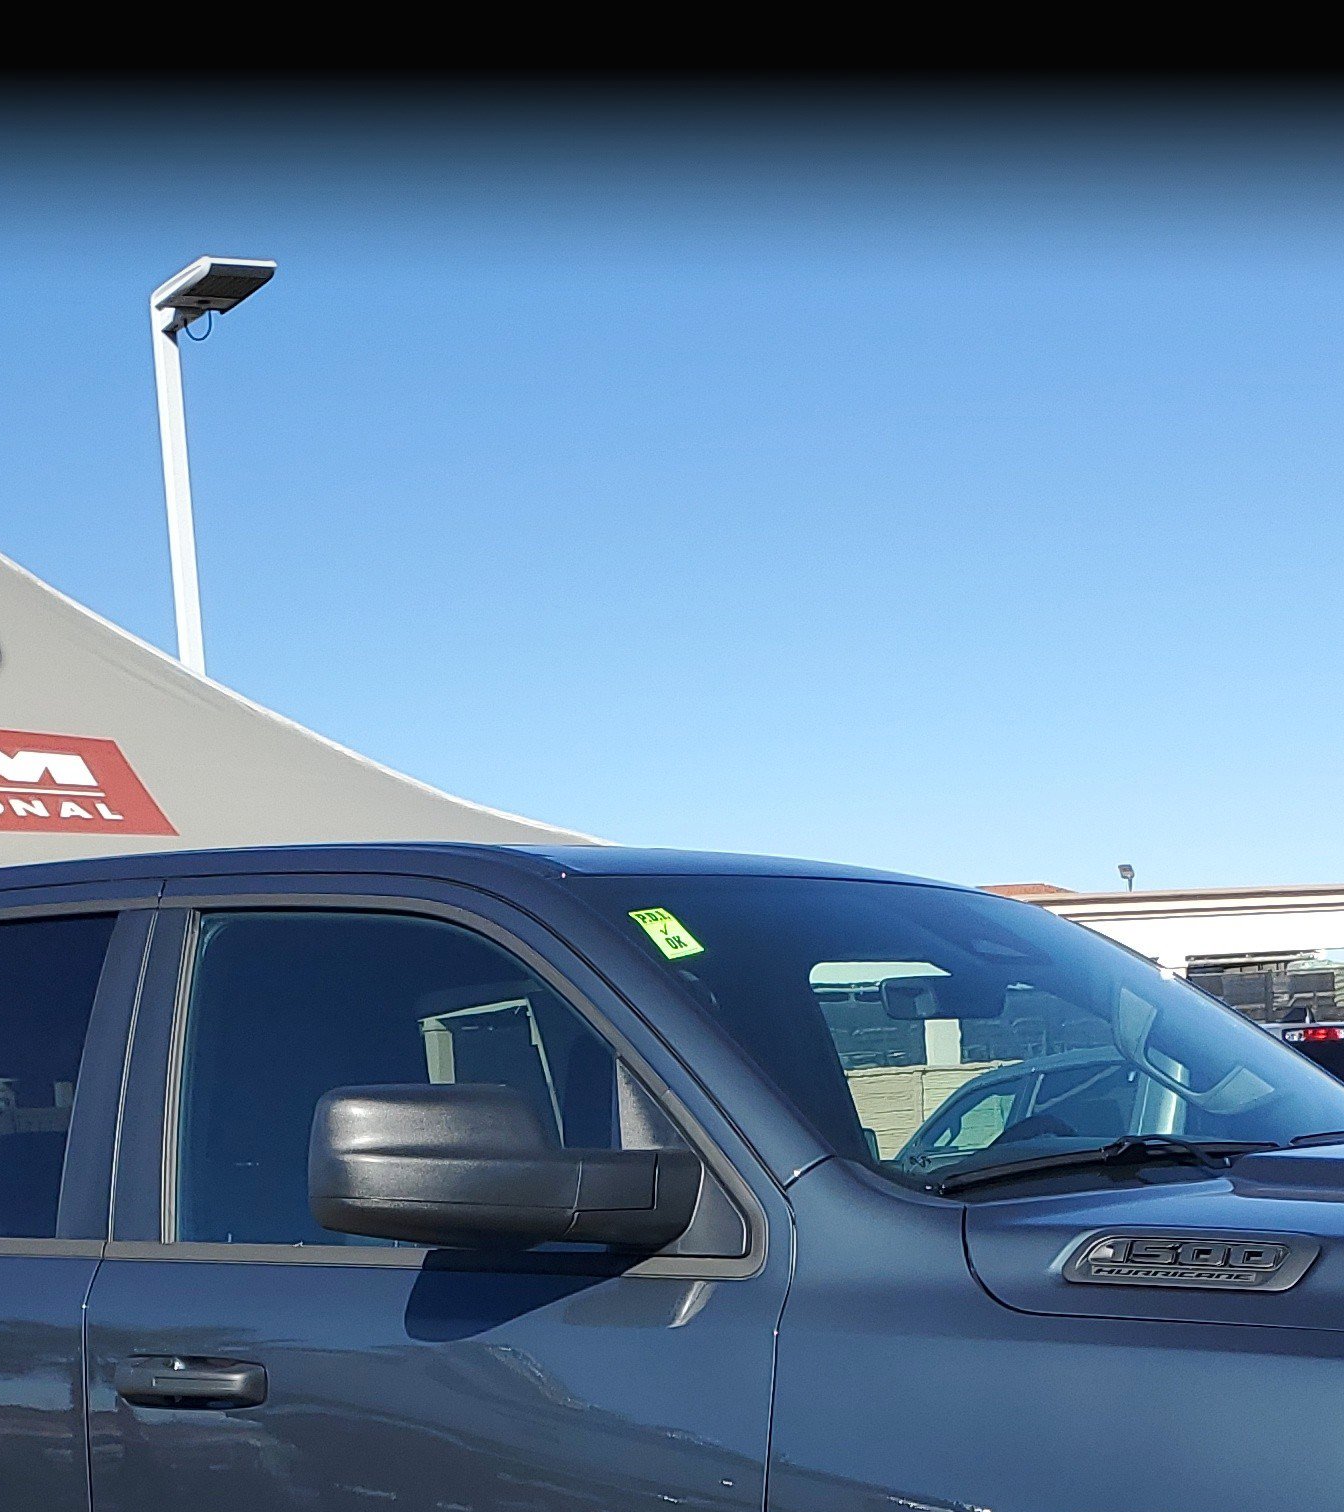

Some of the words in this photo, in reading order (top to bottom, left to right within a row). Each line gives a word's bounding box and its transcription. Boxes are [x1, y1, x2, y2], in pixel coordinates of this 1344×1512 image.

[665, 935, 688, 949] OK
[1089, 1239, 1288, 1269] 1500
[1093, 1267, 1254, 1281] HURRICANE
